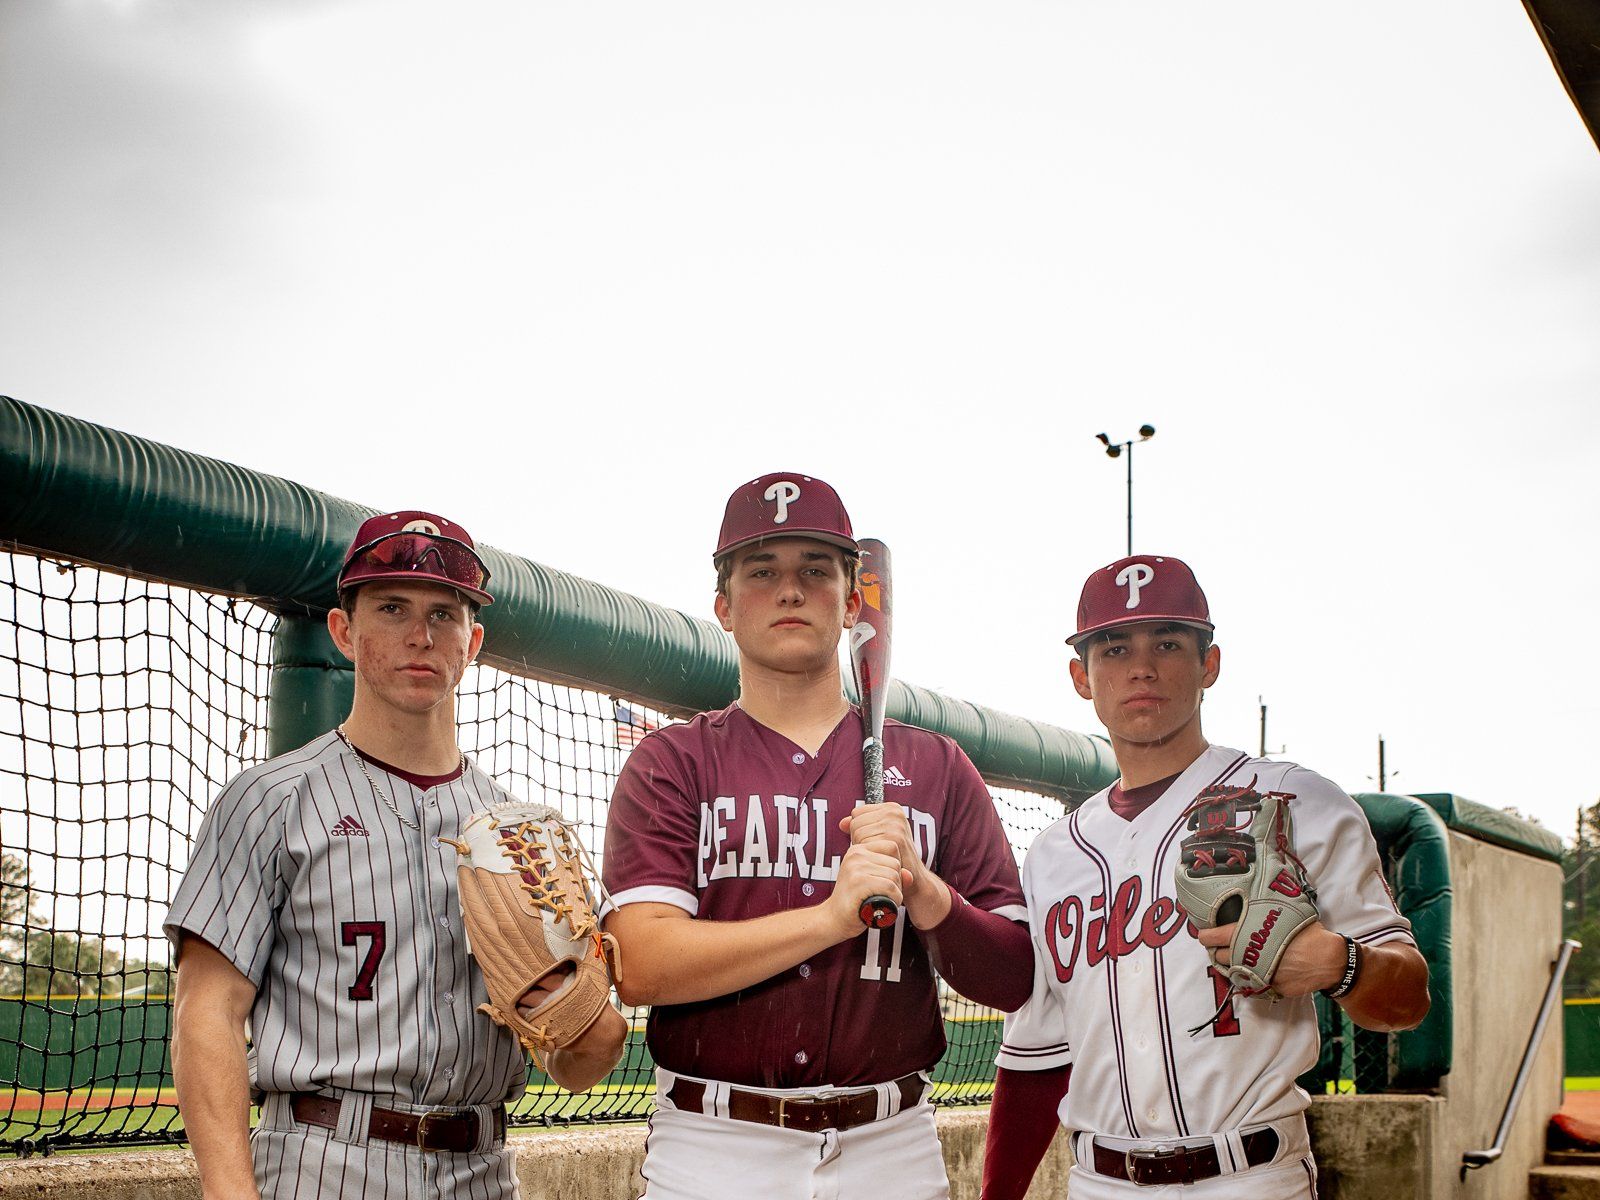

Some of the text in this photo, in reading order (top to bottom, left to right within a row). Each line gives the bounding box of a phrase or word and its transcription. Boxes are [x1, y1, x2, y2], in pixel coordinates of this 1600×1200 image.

[764, 481, 801, 525] P
[1115, 563, 1155, 610] P
[883, 776, 912, 787] didas
[331, 828, 370, 837] adidas
[697, 794, 936, 888] PEARLD
[859, 905, 906, 983] 11
[1045, 875, 1199, 983] Oile
[1242, 909, 1281, 968] Wilson
[341, 921, 386, 1001] 7
[1342, 969, 1355, 984] THE
[1348, 943, 1357, 969] TRUST
